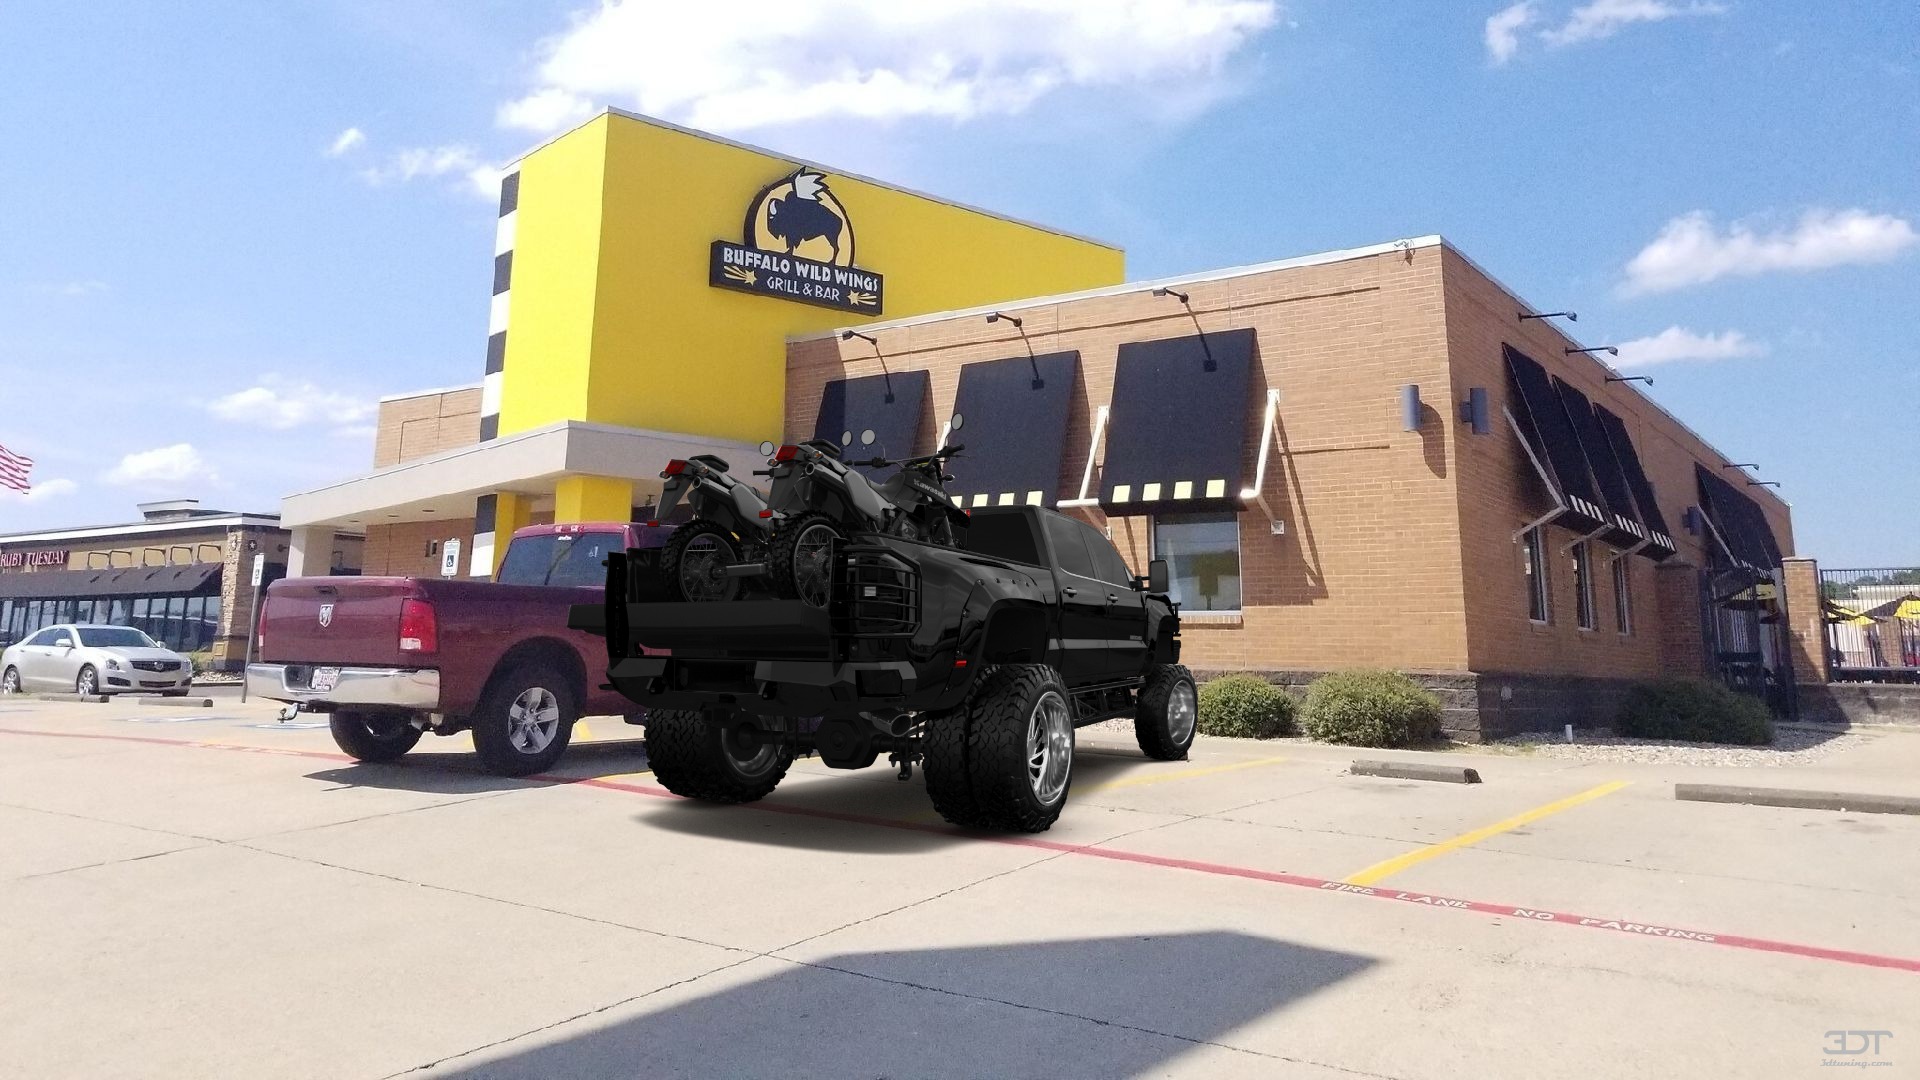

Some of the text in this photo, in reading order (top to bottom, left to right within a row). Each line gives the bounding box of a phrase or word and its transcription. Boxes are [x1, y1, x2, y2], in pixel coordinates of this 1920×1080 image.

[723, 247, 878, 292] BUFFALO WILD WINGS
[766, 276, 840, 301] GRILL & BAR
[0, 550, 65, 567] RUBY TUESDAY
[1320, 881, 1716, 943] FIRE LANE NO PARKING
